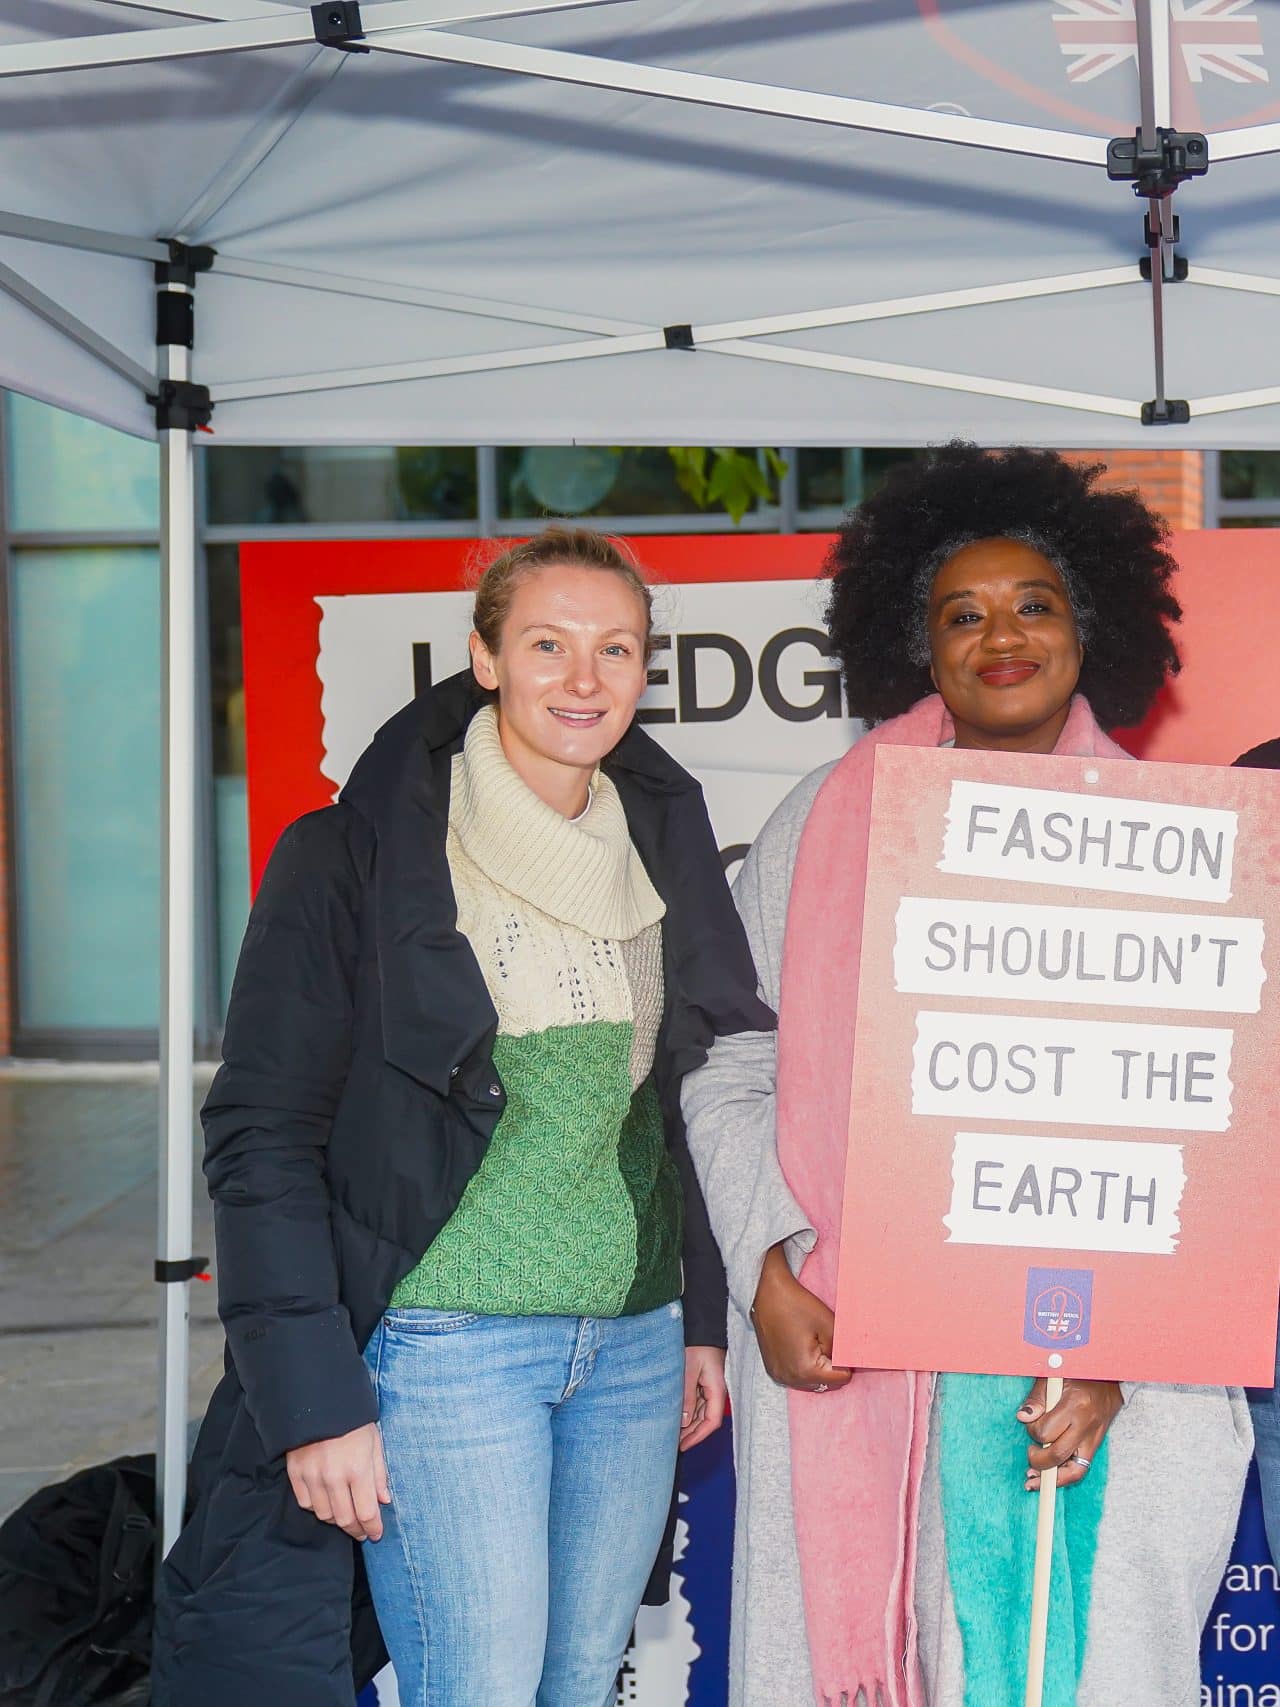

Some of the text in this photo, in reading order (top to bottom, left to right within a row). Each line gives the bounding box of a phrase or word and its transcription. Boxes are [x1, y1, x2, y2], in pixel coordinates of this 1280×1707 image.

[966, 804, 1226, 880] FASHION
[924, 921, 1239, 987] SHOULDN'T
[928, 1041, 1216, 1103] COST THE
[972, 1160, 1156, 1226] EARTH
[1212, 1613, 1275, 1652] for
